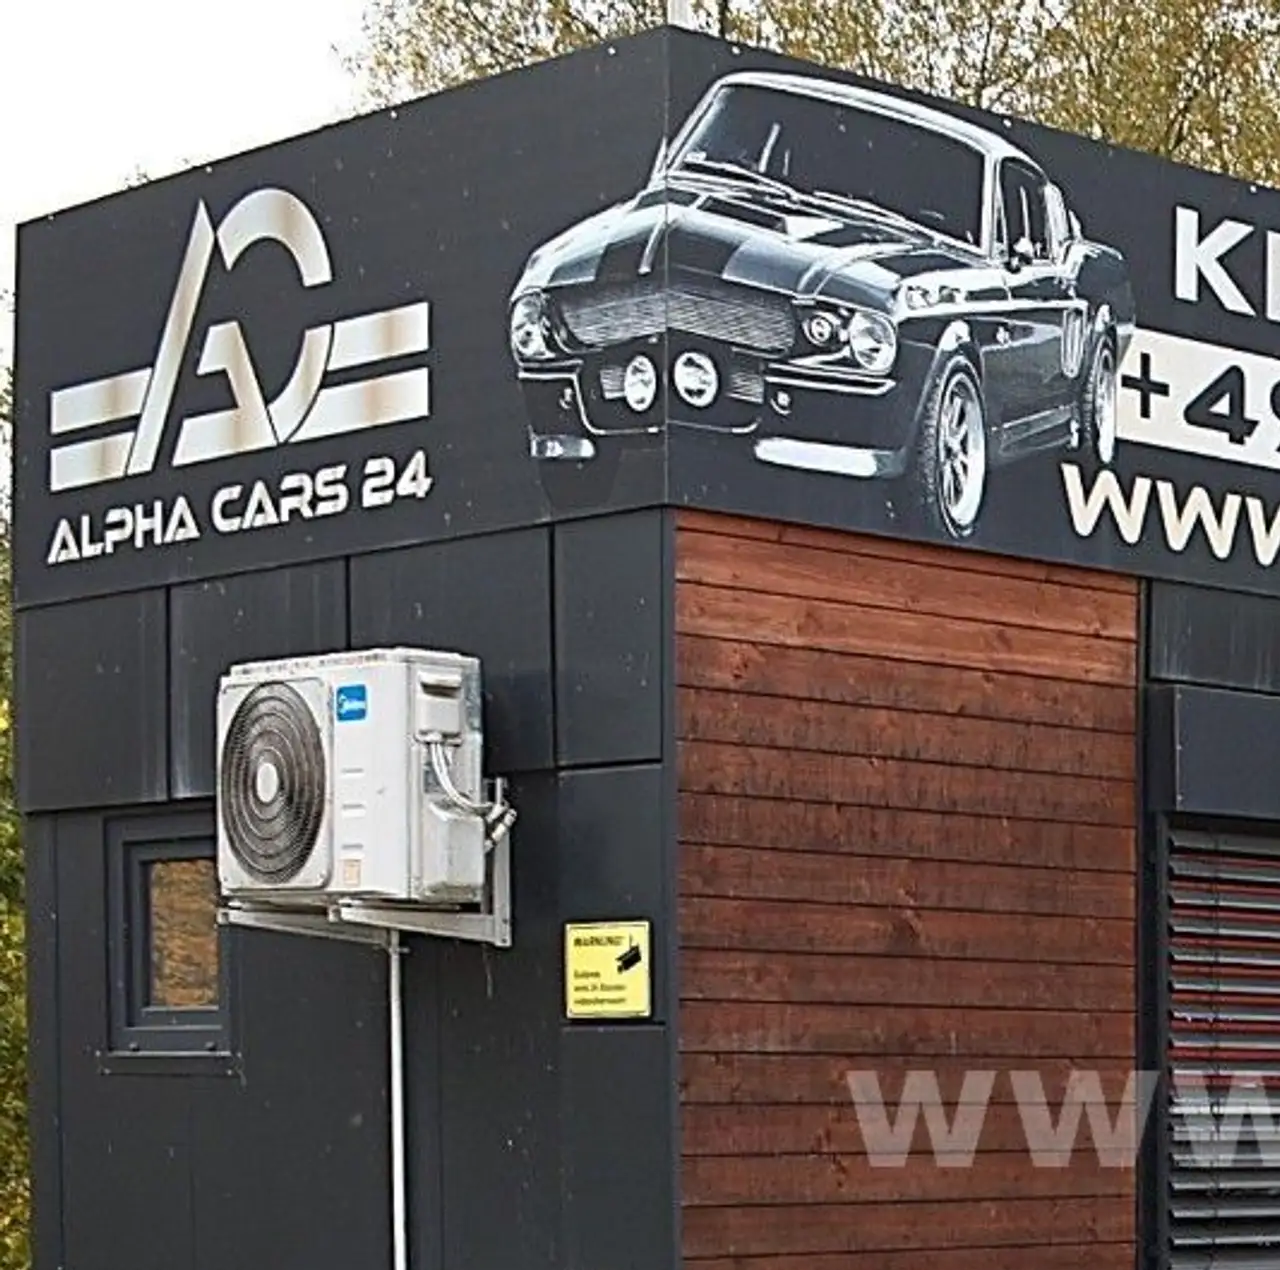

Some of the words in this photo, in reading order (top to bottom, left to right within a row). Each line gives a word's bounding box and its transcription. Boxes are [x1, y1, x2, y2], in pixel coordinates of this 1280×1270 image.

[46, 495, 201, 566] ALPHA
[211, 463, 349, 534] CARS
[362, 451, 432, 508] 24
